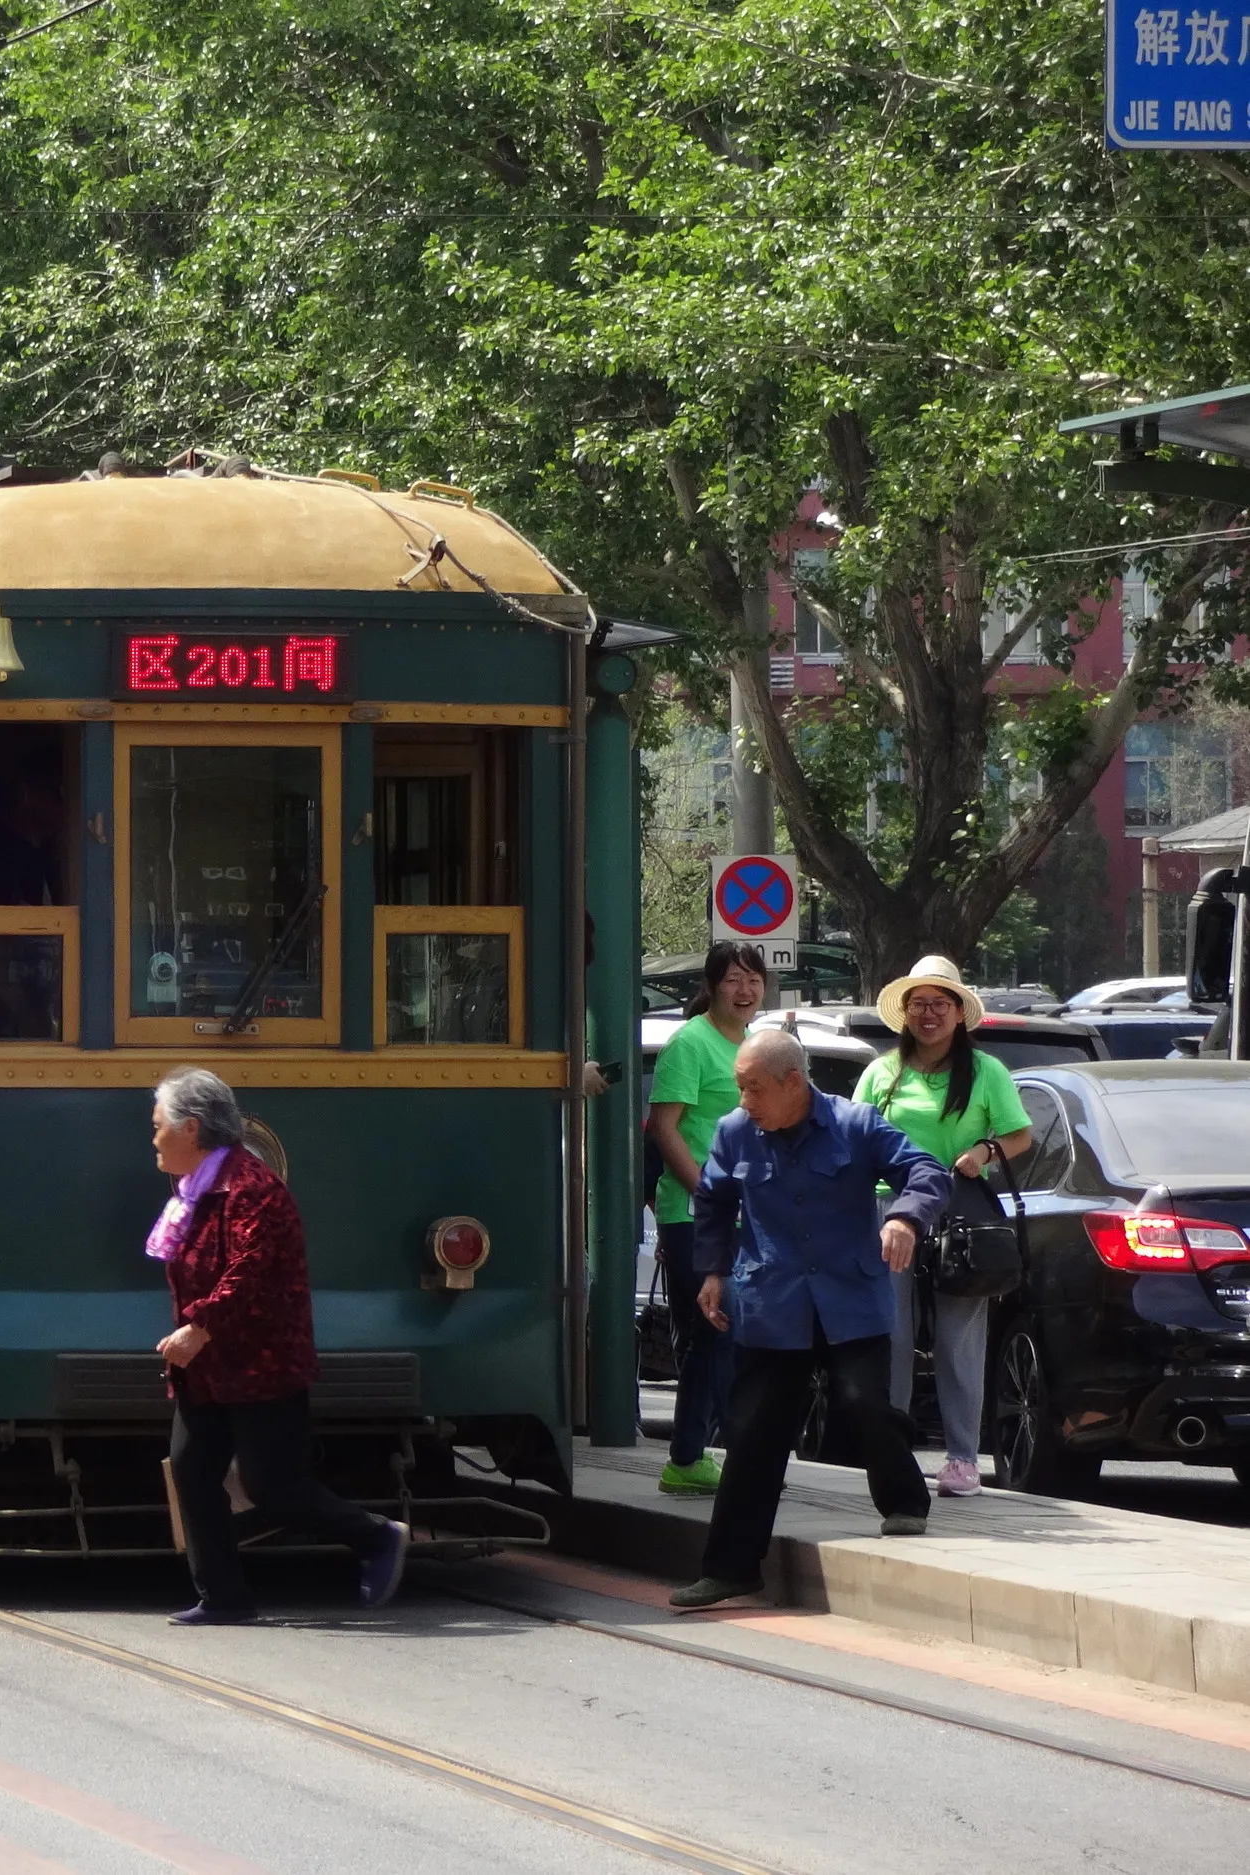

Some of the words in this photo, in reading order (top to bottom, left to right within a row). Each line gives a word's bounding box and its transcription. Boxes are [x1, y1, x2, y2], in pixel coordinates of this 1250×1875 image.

[1134, 8, 1250, 66] 解放
[1124, 100, 1159, 131] JIE
[1173, 100, 1232, 131] FANG
